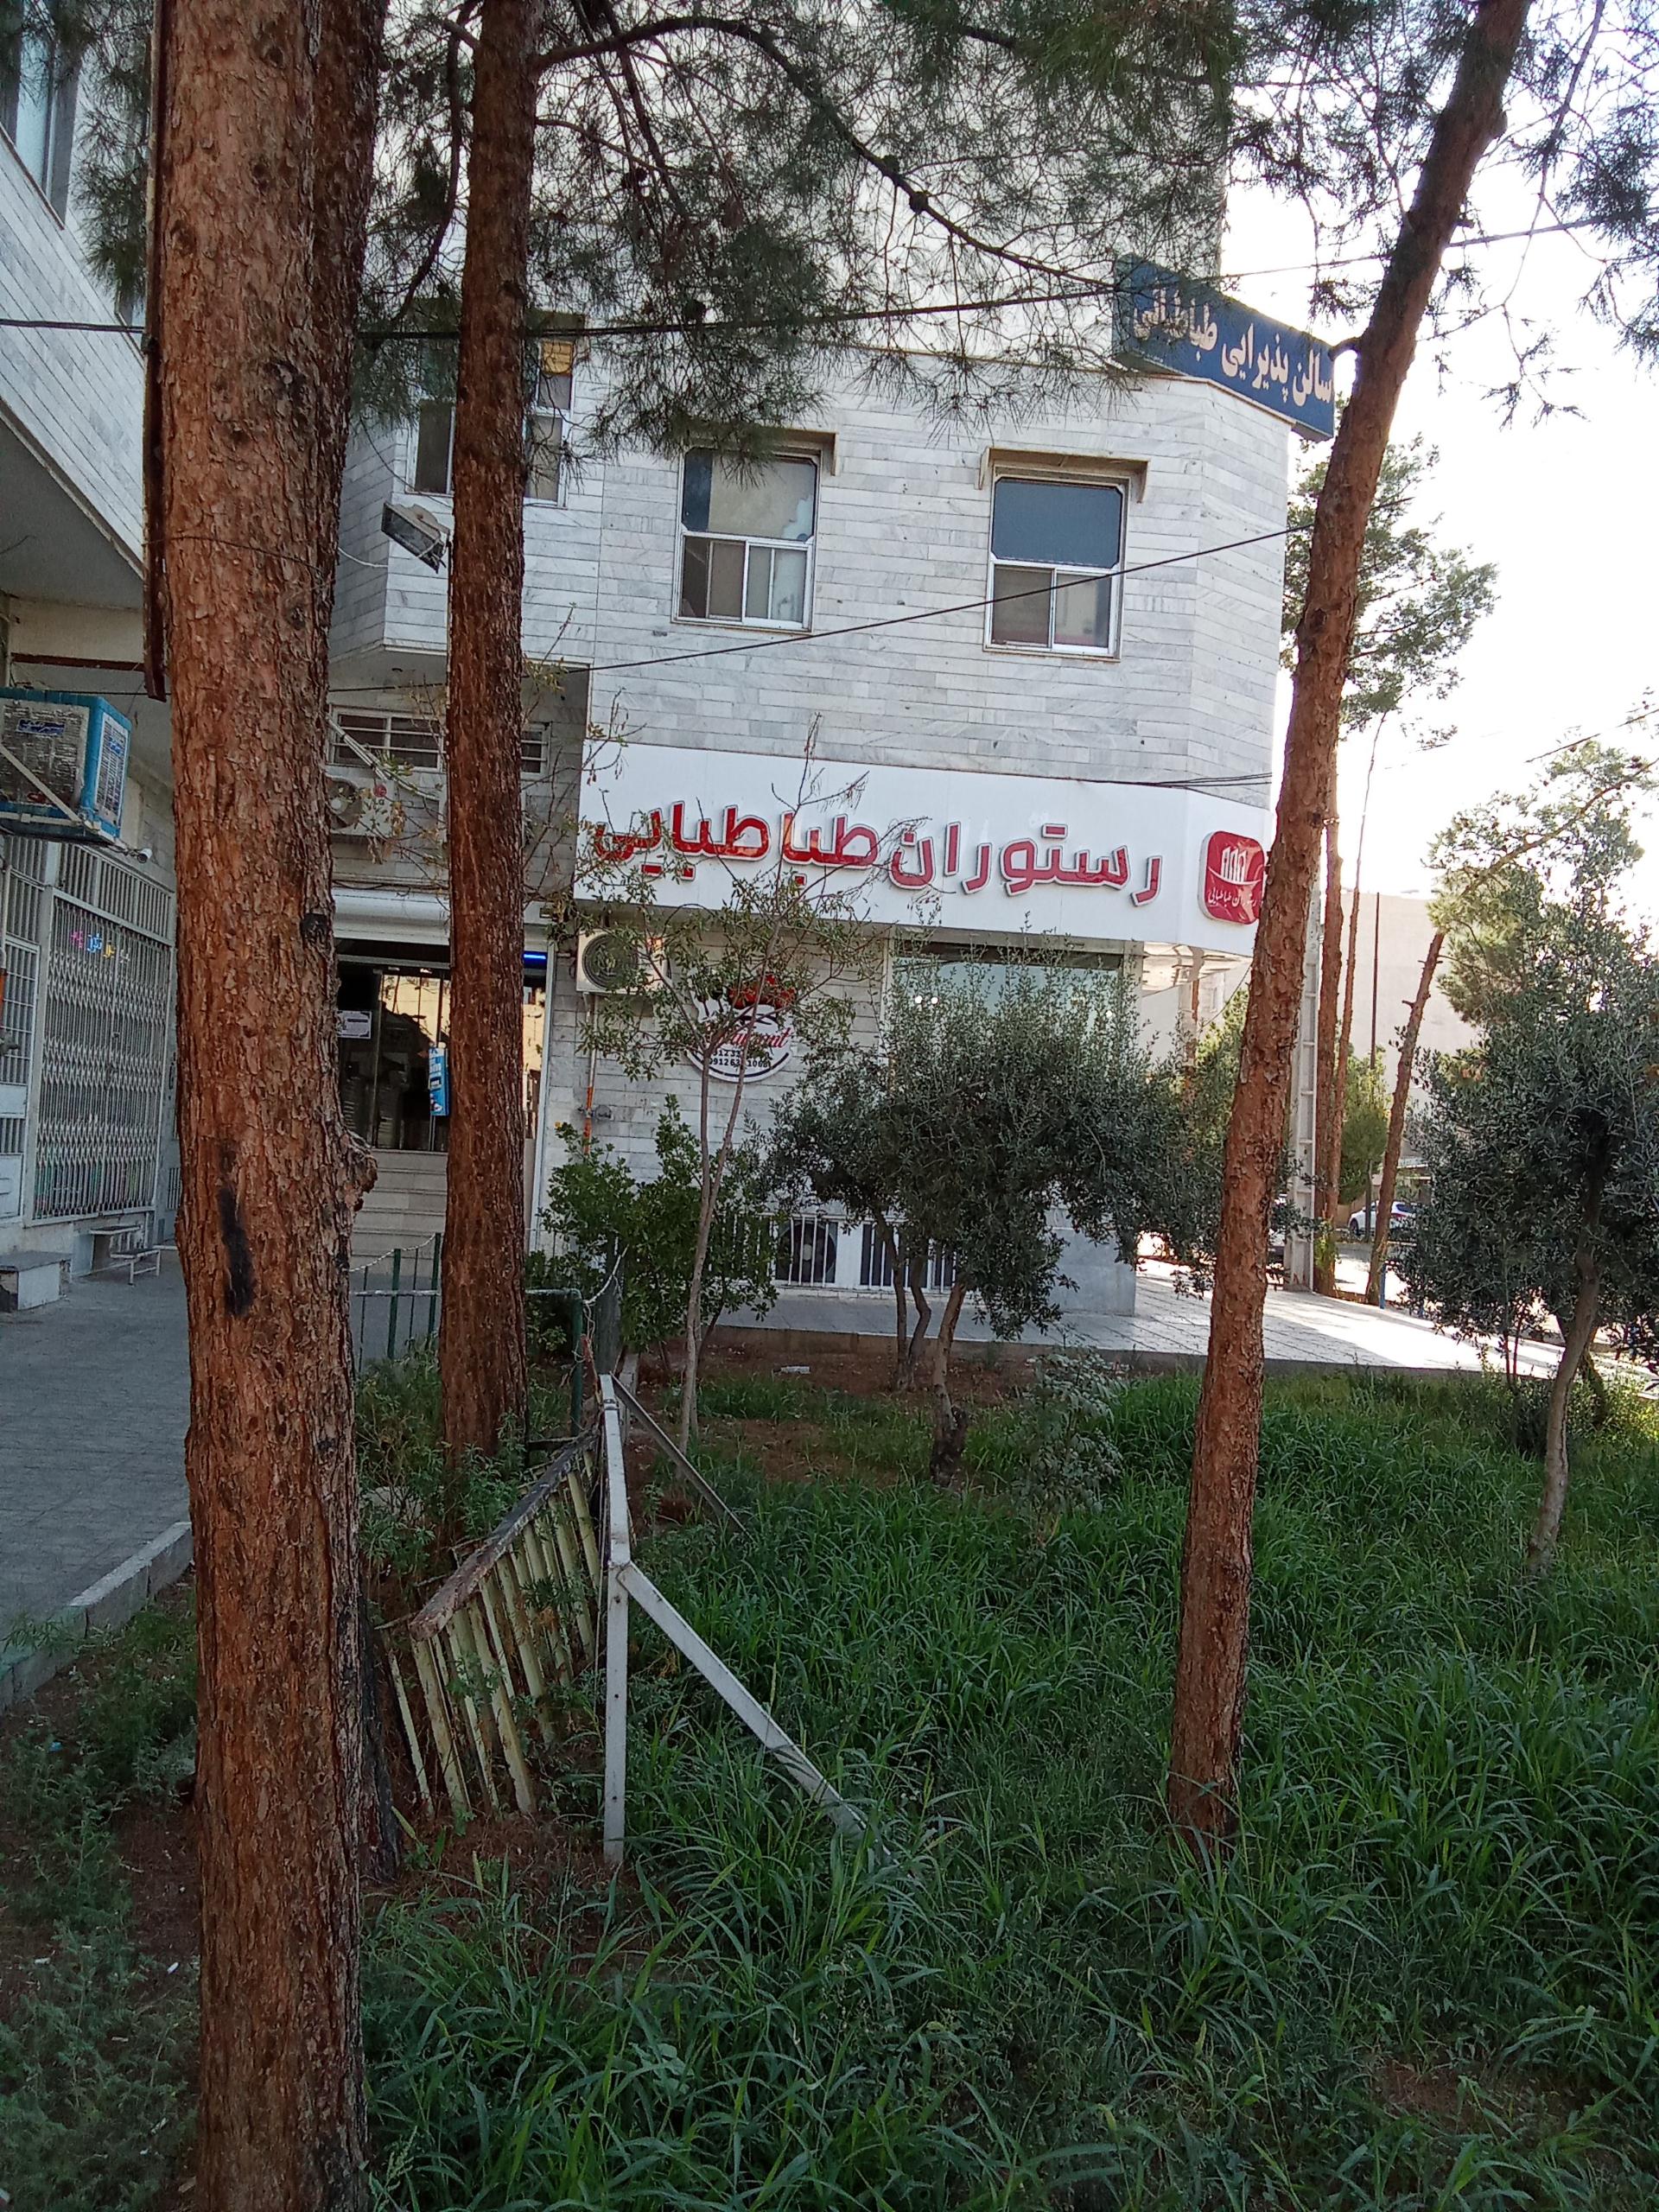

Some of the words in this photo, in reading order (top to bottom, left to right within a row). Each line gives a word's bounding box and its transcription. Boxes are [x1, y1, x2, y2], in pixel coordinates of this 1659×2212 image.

[1222, 323, 1289, 403] پذیرایی
[1293, 349, 1333, 406] سالن
[594, 803, 879, 884] طباطبایی
[889, 822, 1162, 906] رستوران
